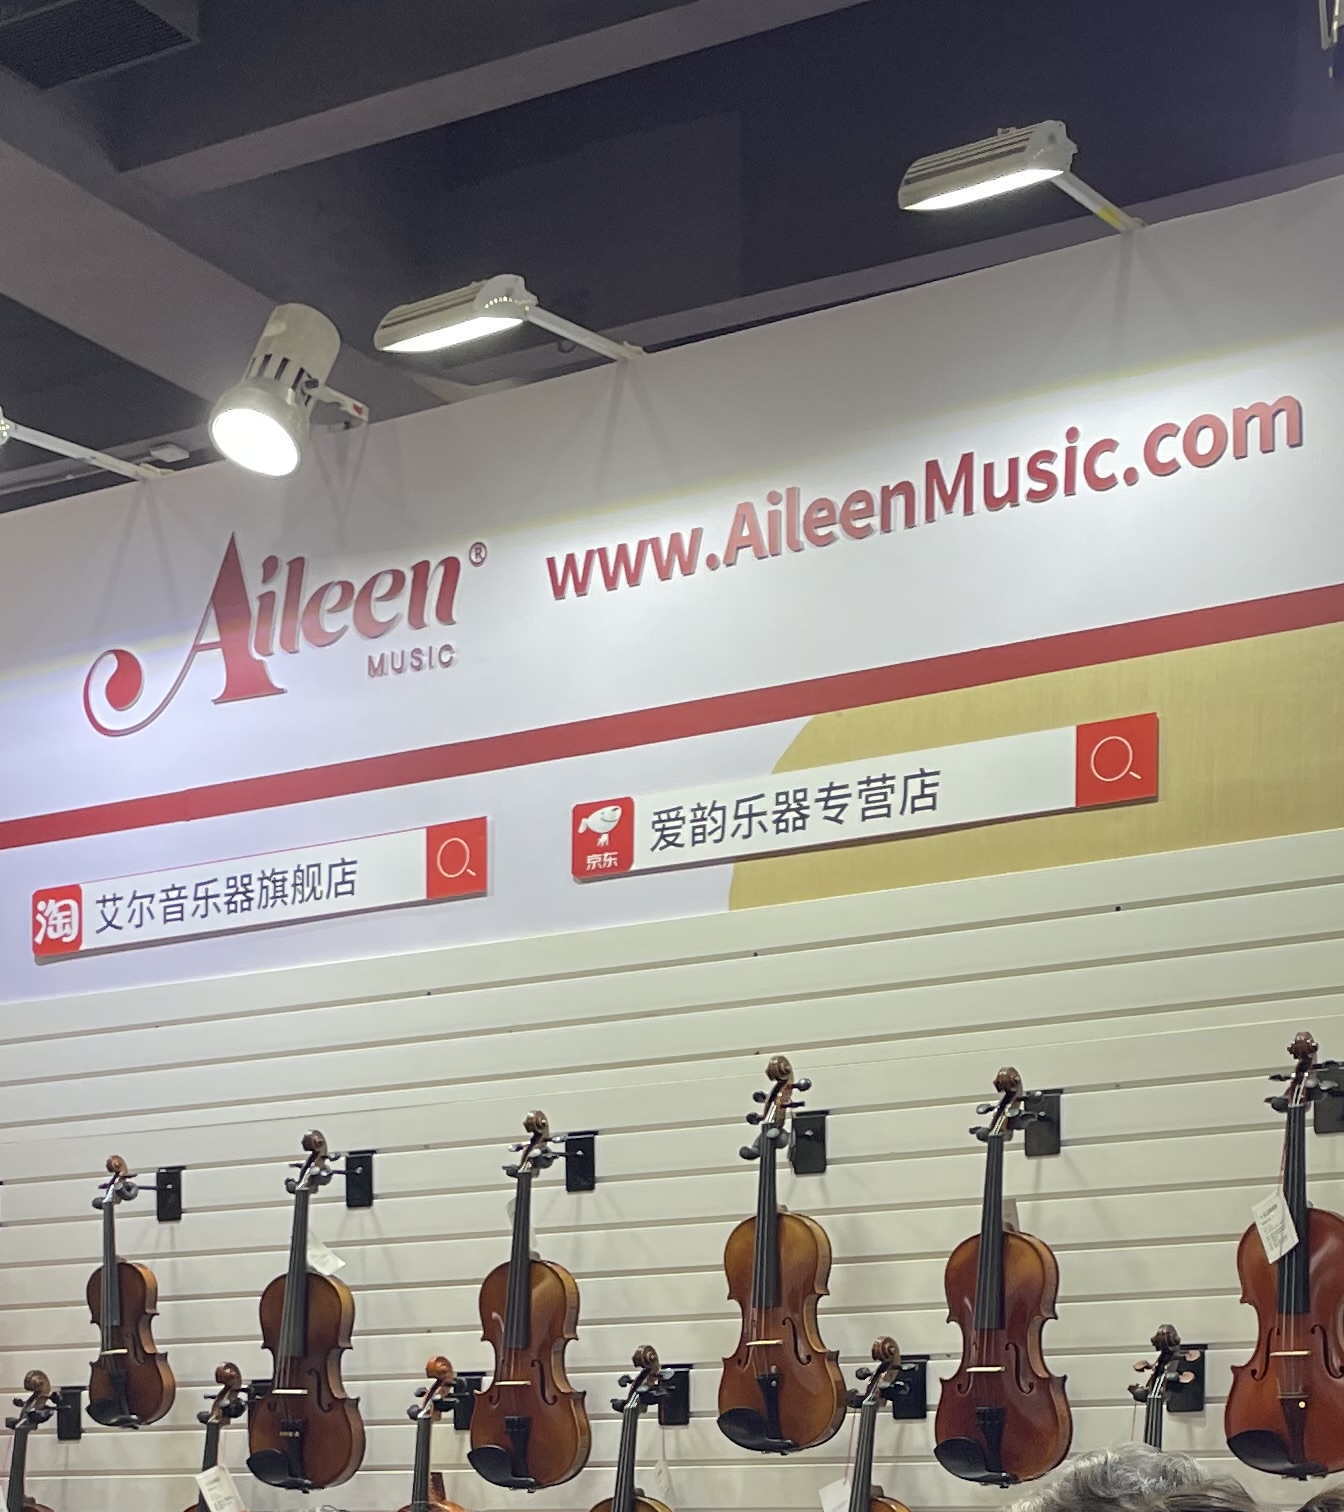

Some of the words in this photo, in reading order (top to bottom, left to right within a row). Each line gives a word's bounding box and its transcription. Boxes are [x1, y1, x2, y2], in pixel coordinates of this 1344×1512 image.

[546, 394, 1304, 600] www.AileenMusic.com
[82, 531, 462, 737] Aileen
[366, 643, 457, 680] MUSIC
[649, 766, 943, 854] 爱韵乐器专营店
[96, 855, 359, 934] 艾尔音乐器旗舰店
[585, 850, 620, 871] 京东
[34, 897, 80, 946] 淘
